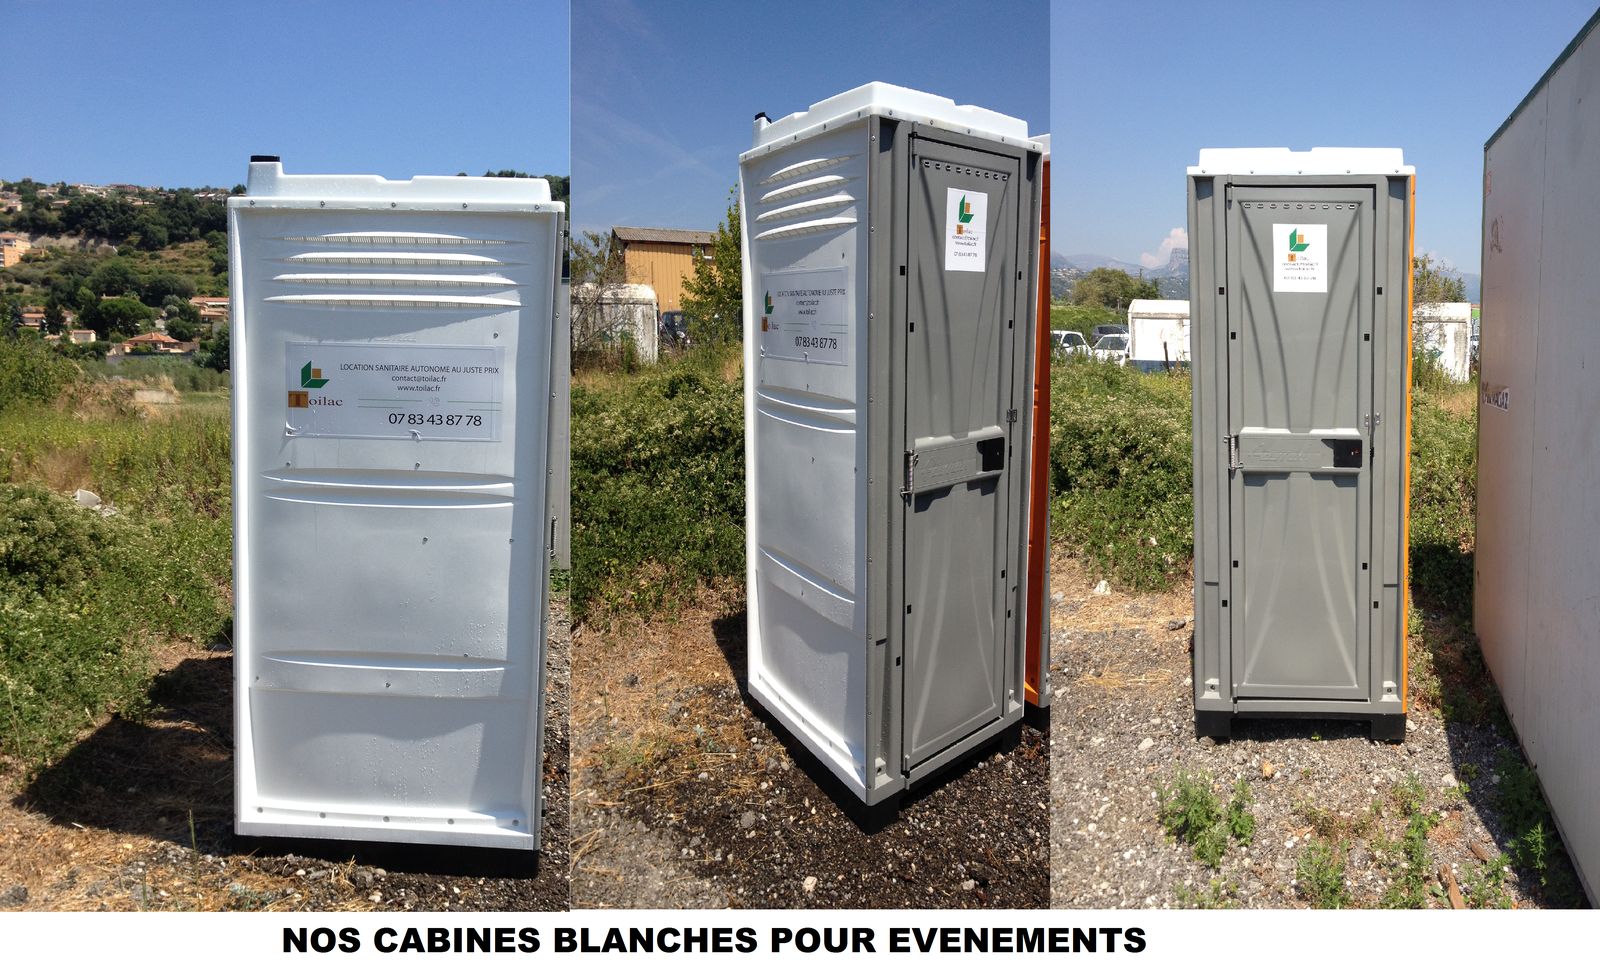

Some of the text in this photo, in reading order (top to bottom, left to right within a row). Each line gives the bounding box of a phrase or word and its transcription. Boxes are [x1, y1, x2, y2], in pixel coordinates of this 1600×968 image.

[802, 336, 810, 348] 83
[811, 337, 818, 348] 43
[819, 337, 828, 349] 87
[828, 338, 837, 350] 78
[340, 363, 374, 371] LOCATION
[374, 364, 409, 372] SANITAIRE
[410, 365, 450, 373] AUTONOME
[462, 366, 483, 374] JUSTE
[391, 375, 447, 383] contact@toilac.fr
[397, 384, 440, 392] www.toilac.fr
[288, 391, 343, 408] Toilac
[388, 413, 482, 427] 07 83 43 87 78
